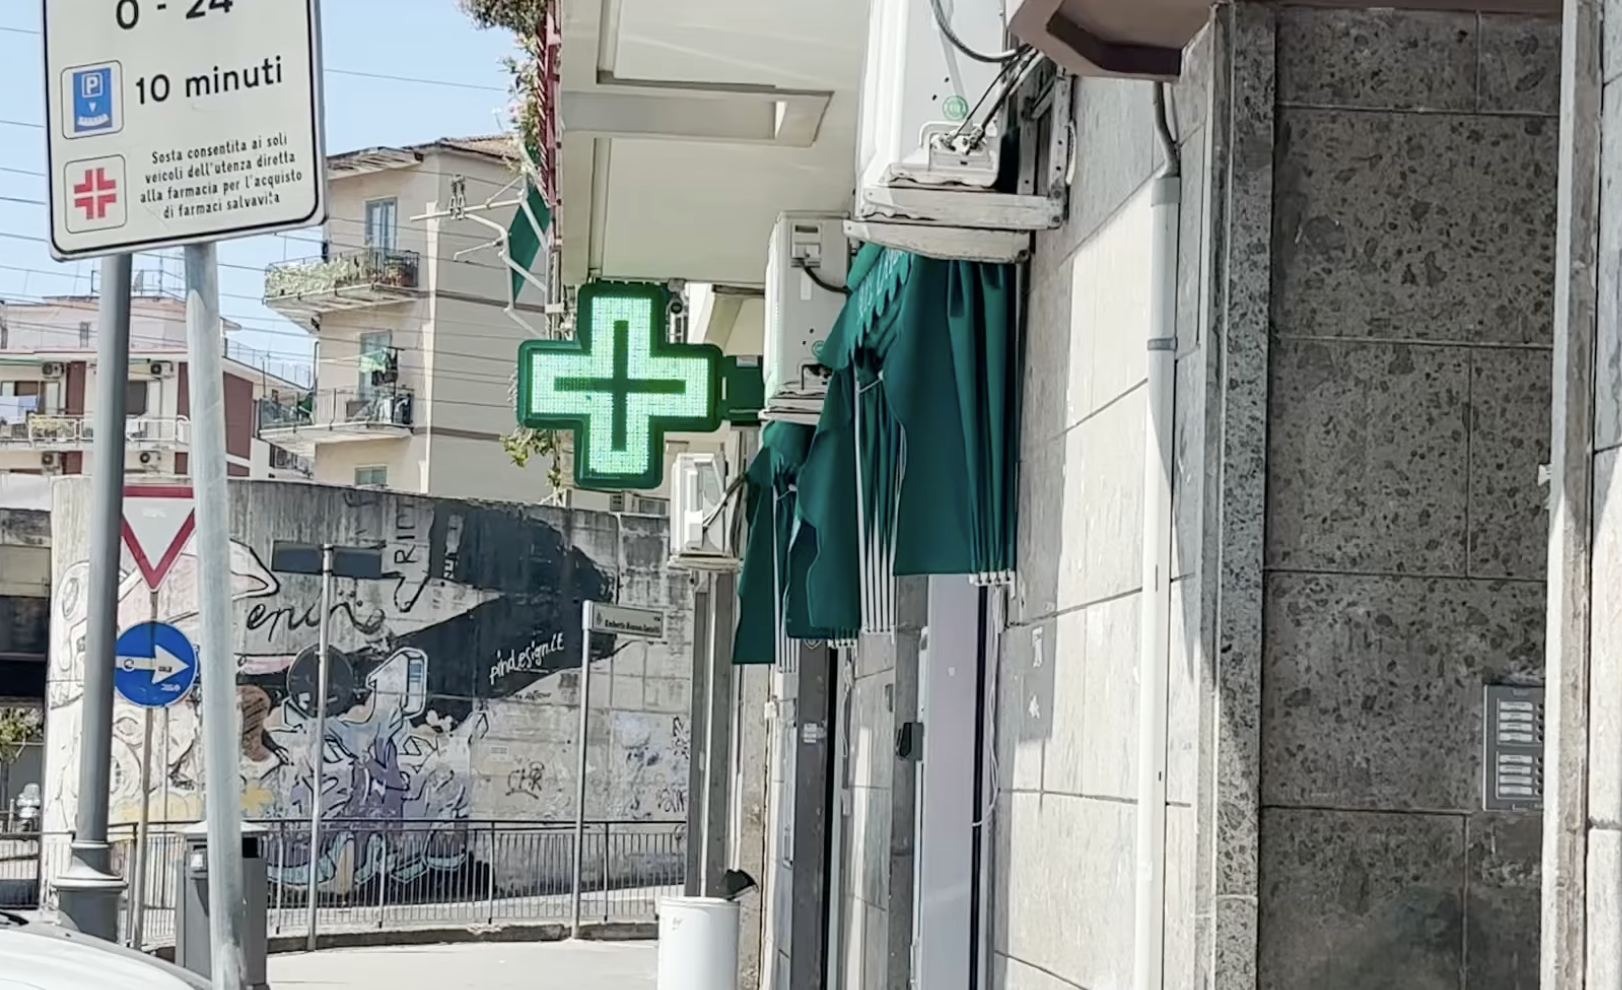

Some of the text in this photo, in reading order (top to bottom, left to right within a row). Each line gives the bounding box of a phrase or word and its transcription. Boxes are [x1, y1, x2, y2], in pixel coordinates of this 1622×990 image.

[116, 0, 139, 30] 0
[86, 76, 99, 95] P
[136, 55, 282, 105] 10 minuti
[151, 132, 287, 164] Sosta consentita ai soli
[145, 150, 295, 184] veicoli dell'utenza diretta
[140, 169, 302, 203] alla farmacia per l'acquisto
[163, 191, 280, 219] di farmaci salvavita
